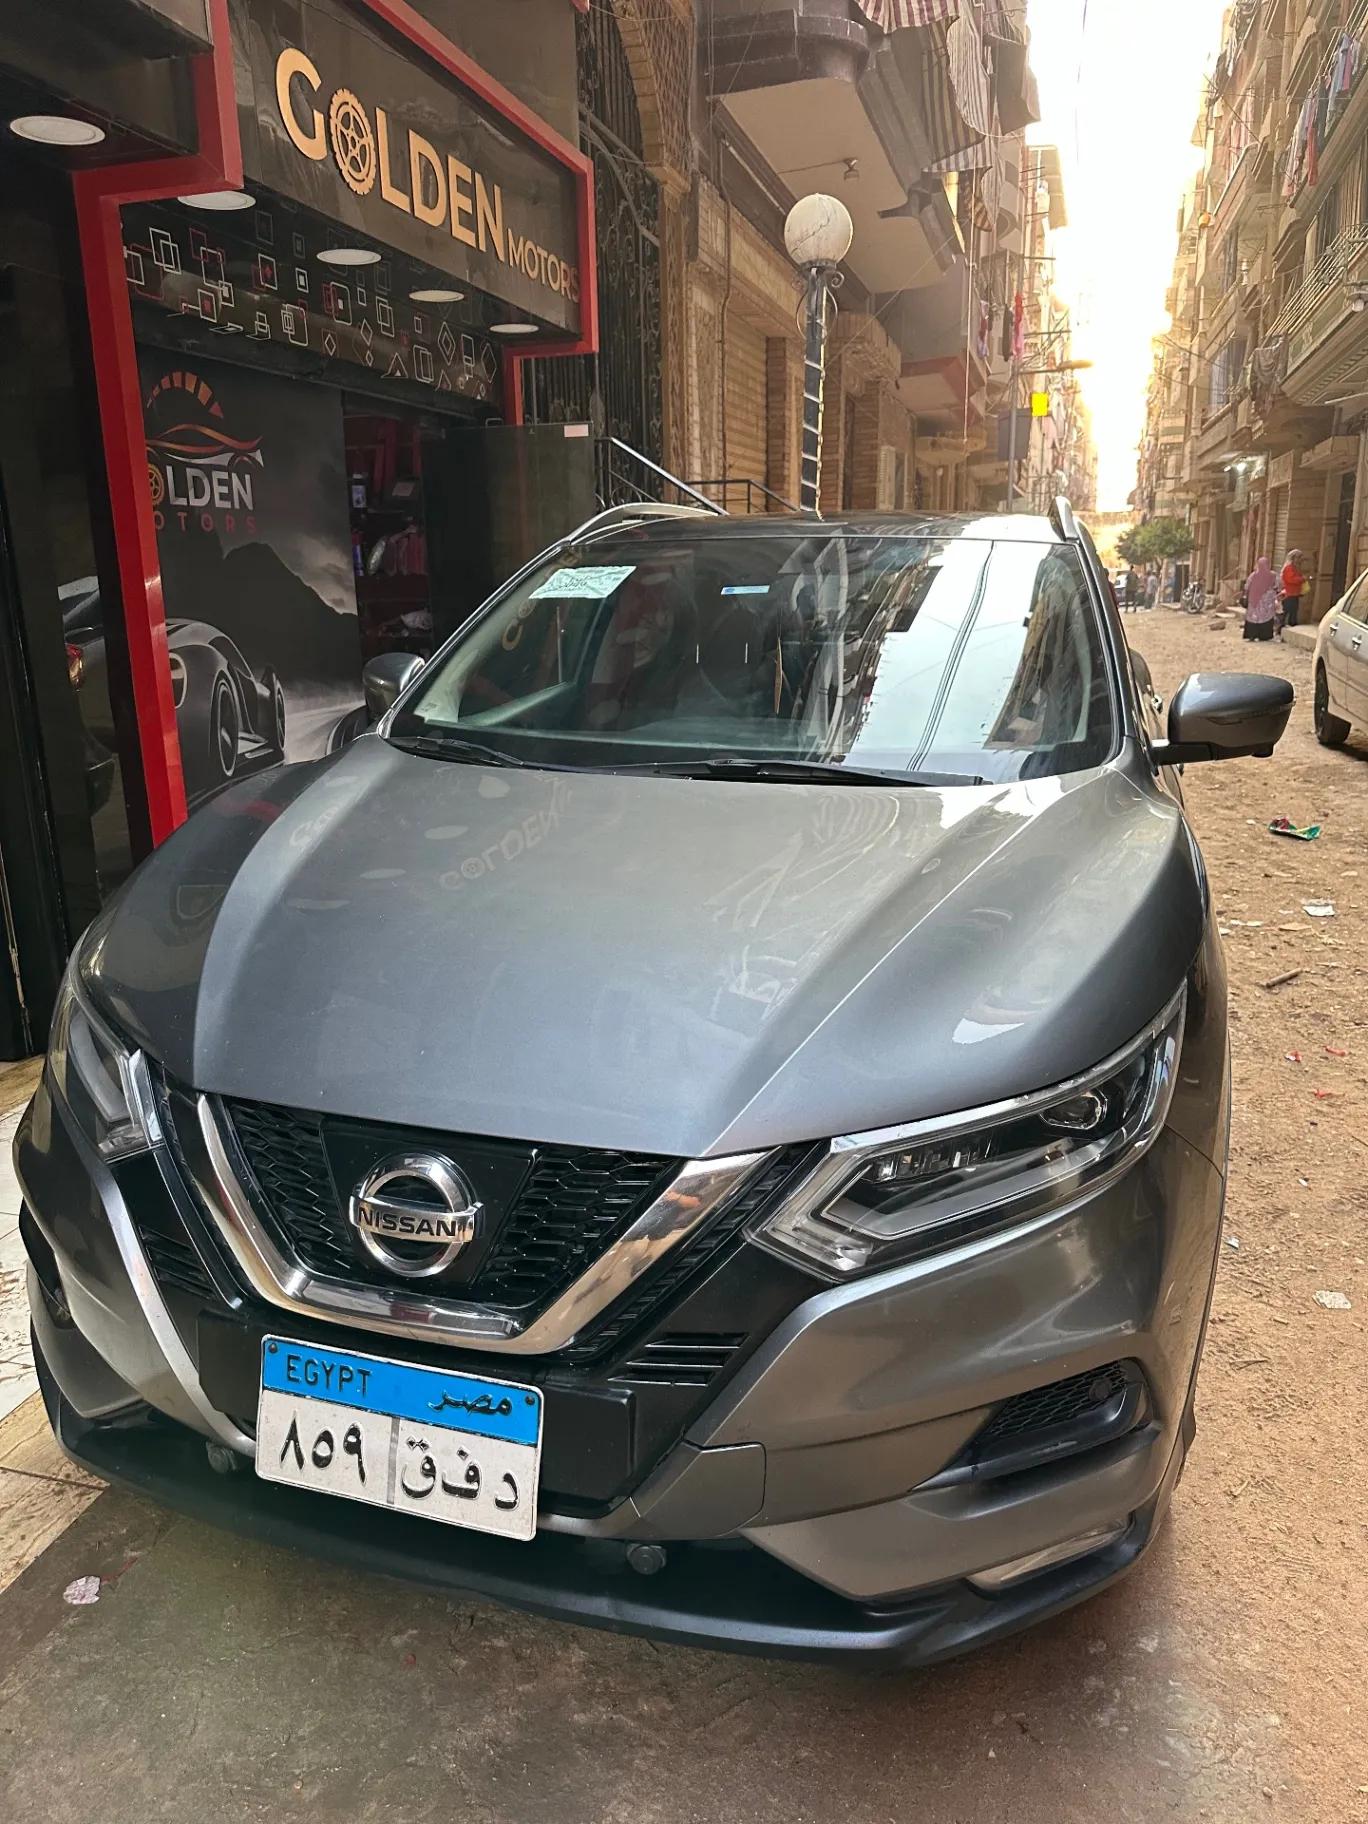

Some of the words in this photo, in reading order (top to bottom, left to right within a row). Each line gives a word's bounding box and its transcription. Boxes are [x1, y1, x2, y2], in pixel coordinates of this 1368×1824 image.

[276, 47, 505, 263] GOLDEN
[148, 463, 254, 511] OLDEN
[153, 510, 257, 534] OTORS
[359, 1206, 456, 1237] NISSAN
[286, 1354, 371, 1397] EGYPT
[428, 1391, 512, 1416] مصر
[280, 1417, 366, 1485] ٨٥٩
